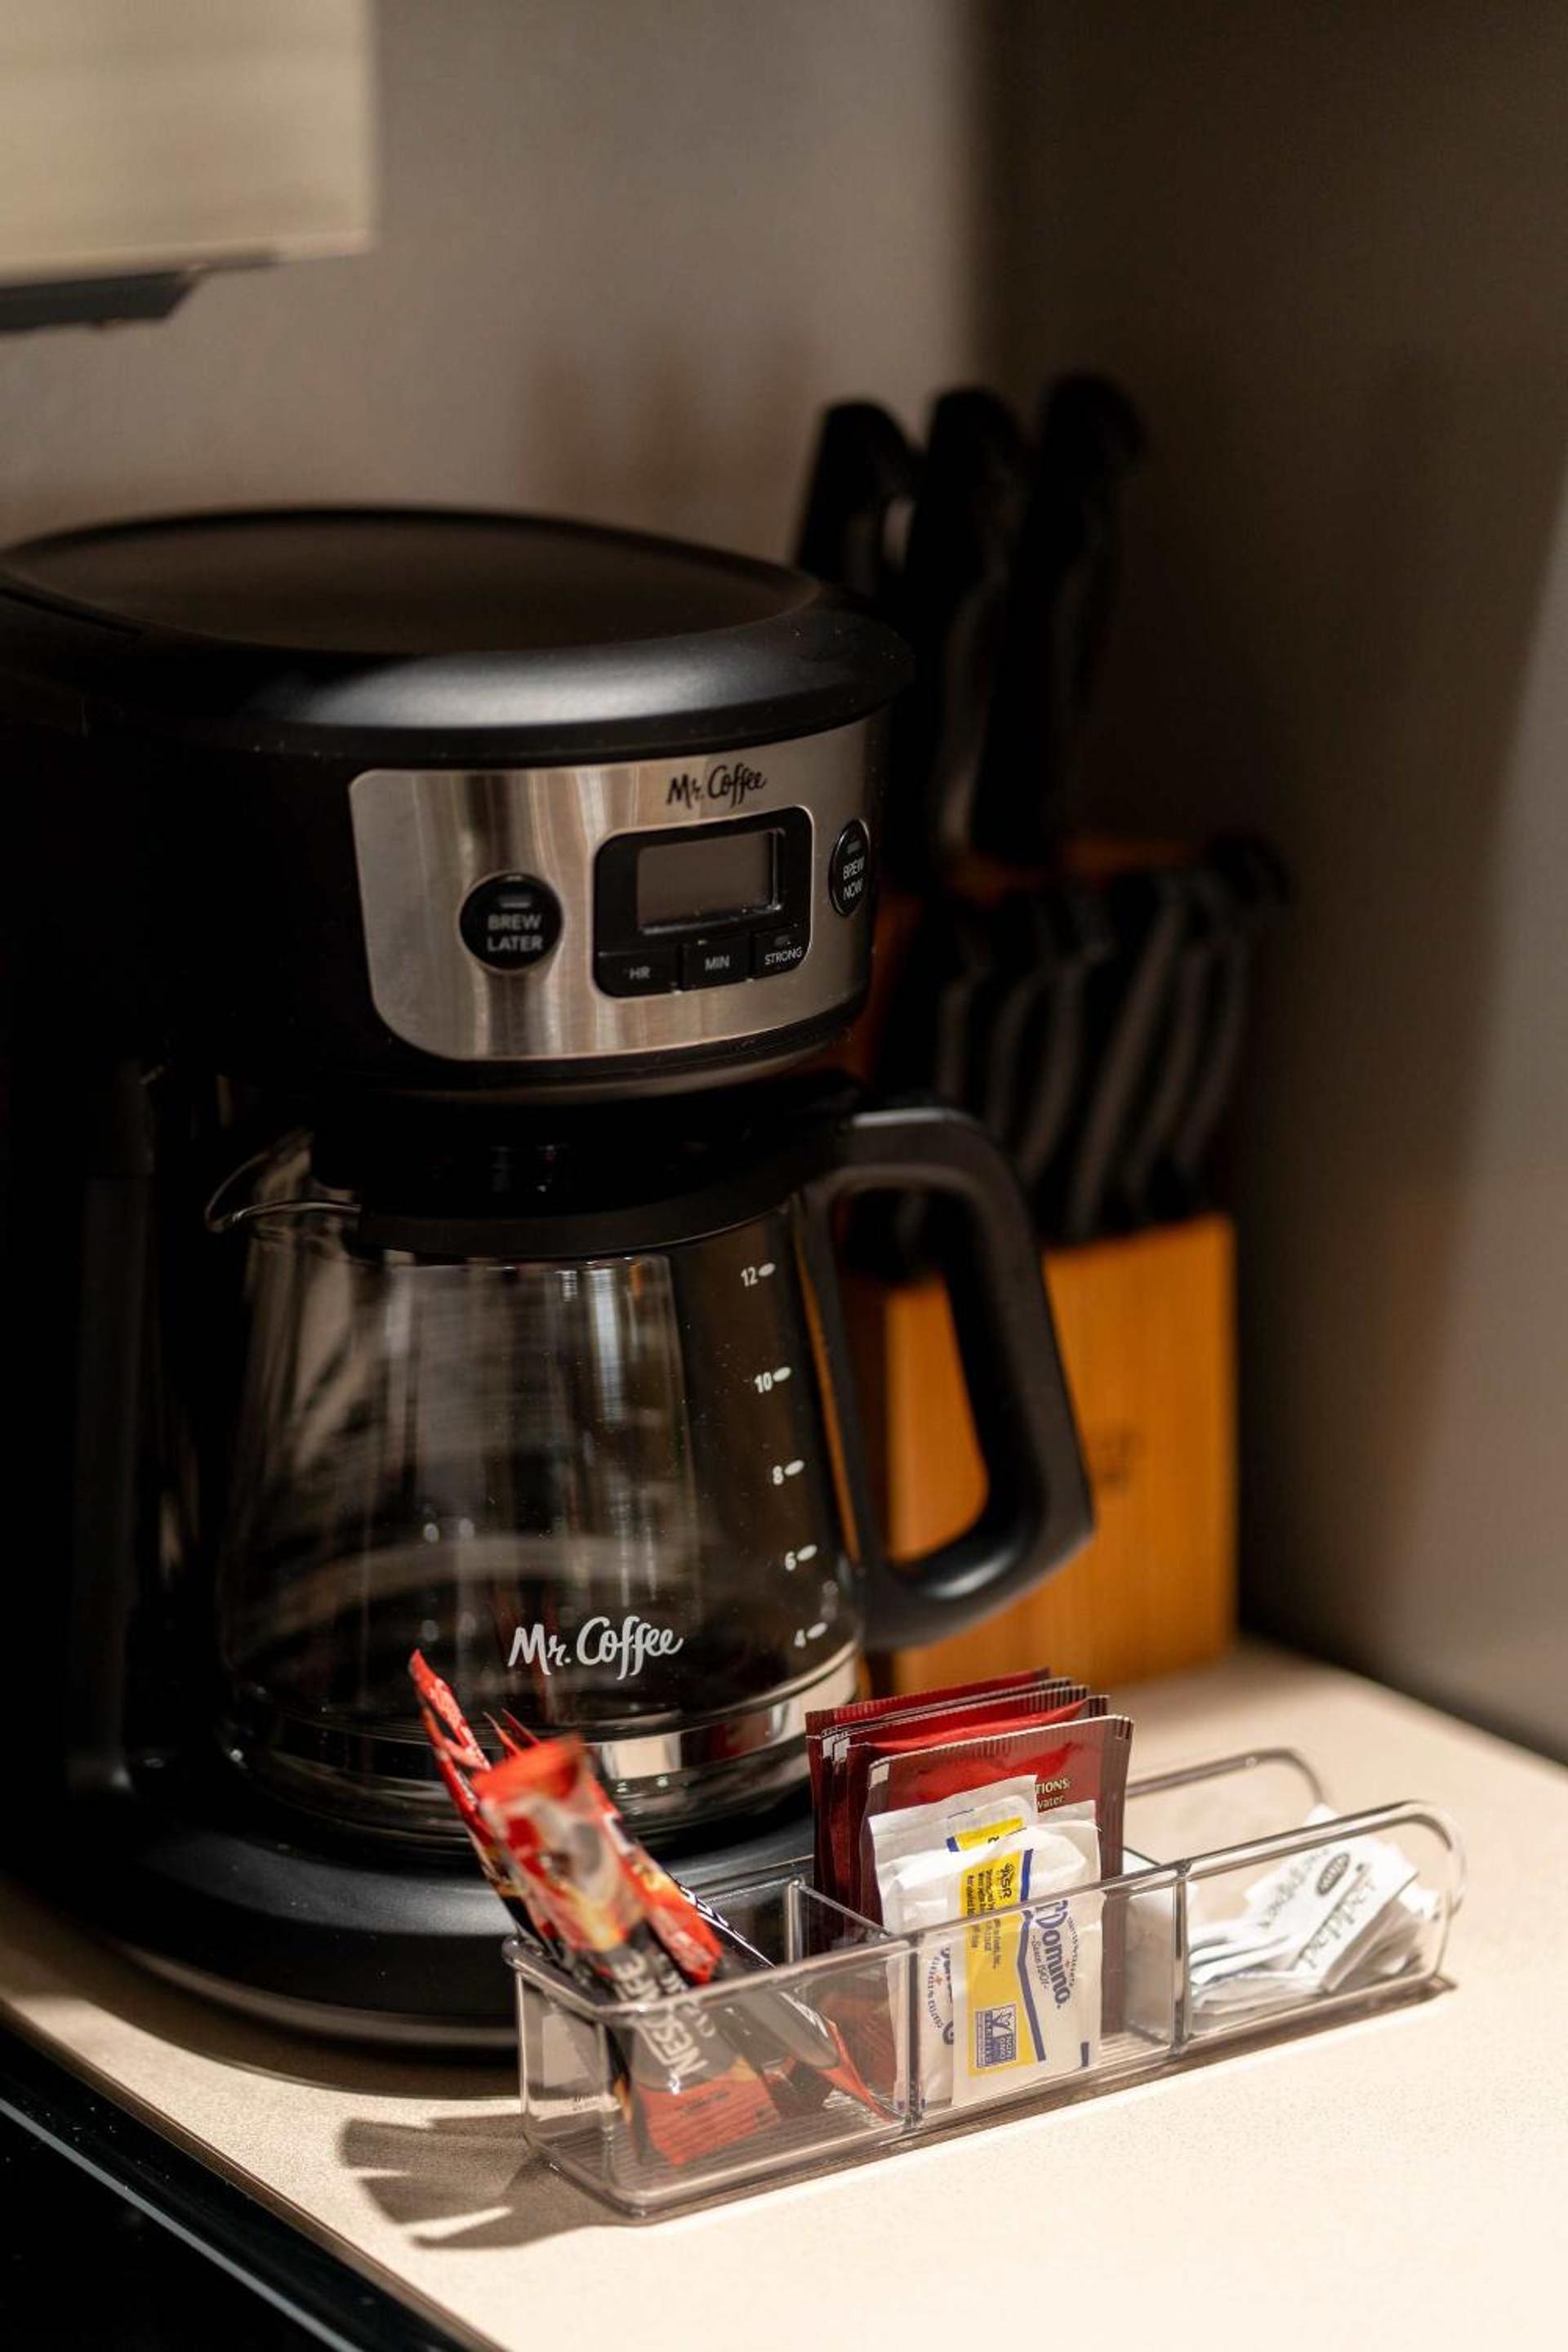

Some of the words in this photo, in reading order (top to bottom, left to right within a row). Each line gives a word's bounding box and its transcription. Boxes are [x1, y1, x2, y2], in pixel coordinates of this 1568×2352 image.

[666, 773, 705, 809] Mr.
[707, 762, 768, 808] Coffee
[843, 856, 865, 880] BREW
[843, 877, 864, 900] NOW
[488, 913, 542, 930] BREW
[487, 935, 544, 952] LATER
[705, 955, 731, 971] MIN
[764, 946, 803, 966] STRONG
[629, 965, 651, 979] HR
[741, 1266, 758, 1287] 12
[755, 1371, 773, 1393] 10
[773, 1465, 784, 1486] 8
[785, 1551, 797, 1571] 6
[507, 1623, 572, 1676] Mr.
[576, 1615, 684, 1681] Coffee
[1036, 1900, 1071, 2006] Domino
